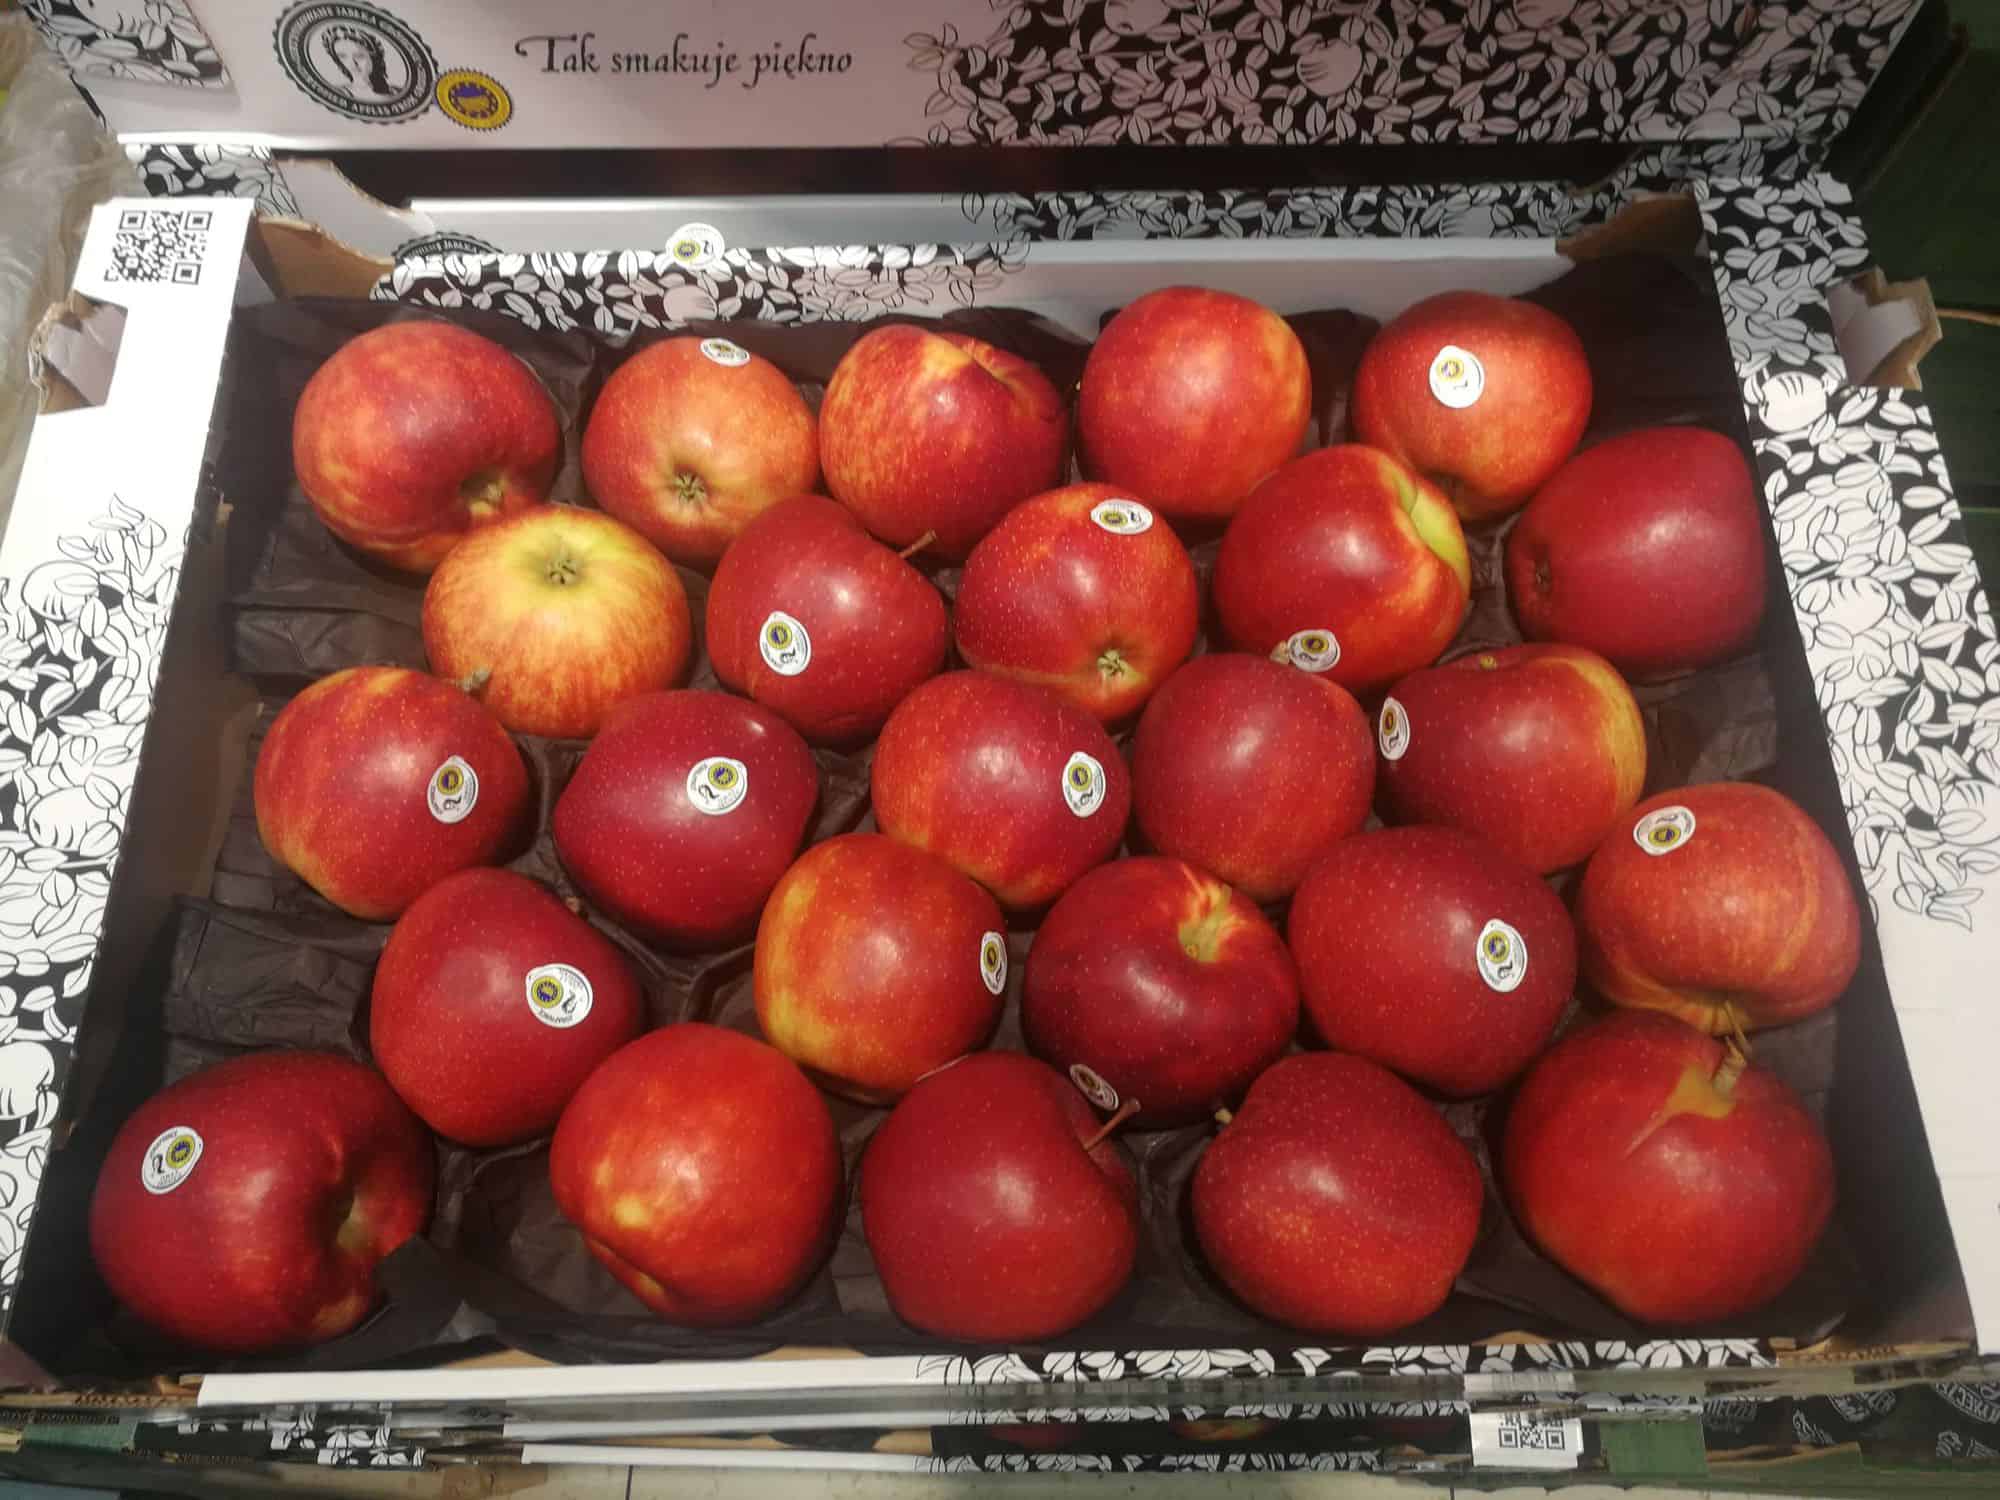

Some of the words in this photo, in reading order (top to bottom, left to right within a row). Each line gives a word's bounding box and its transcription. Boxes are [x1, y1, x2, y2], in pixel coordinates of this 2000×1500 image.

[515, 33, 600, 73] Tak
[611, 33, 741, 89] smakuje
[742, 33, 853, 90] piękno
